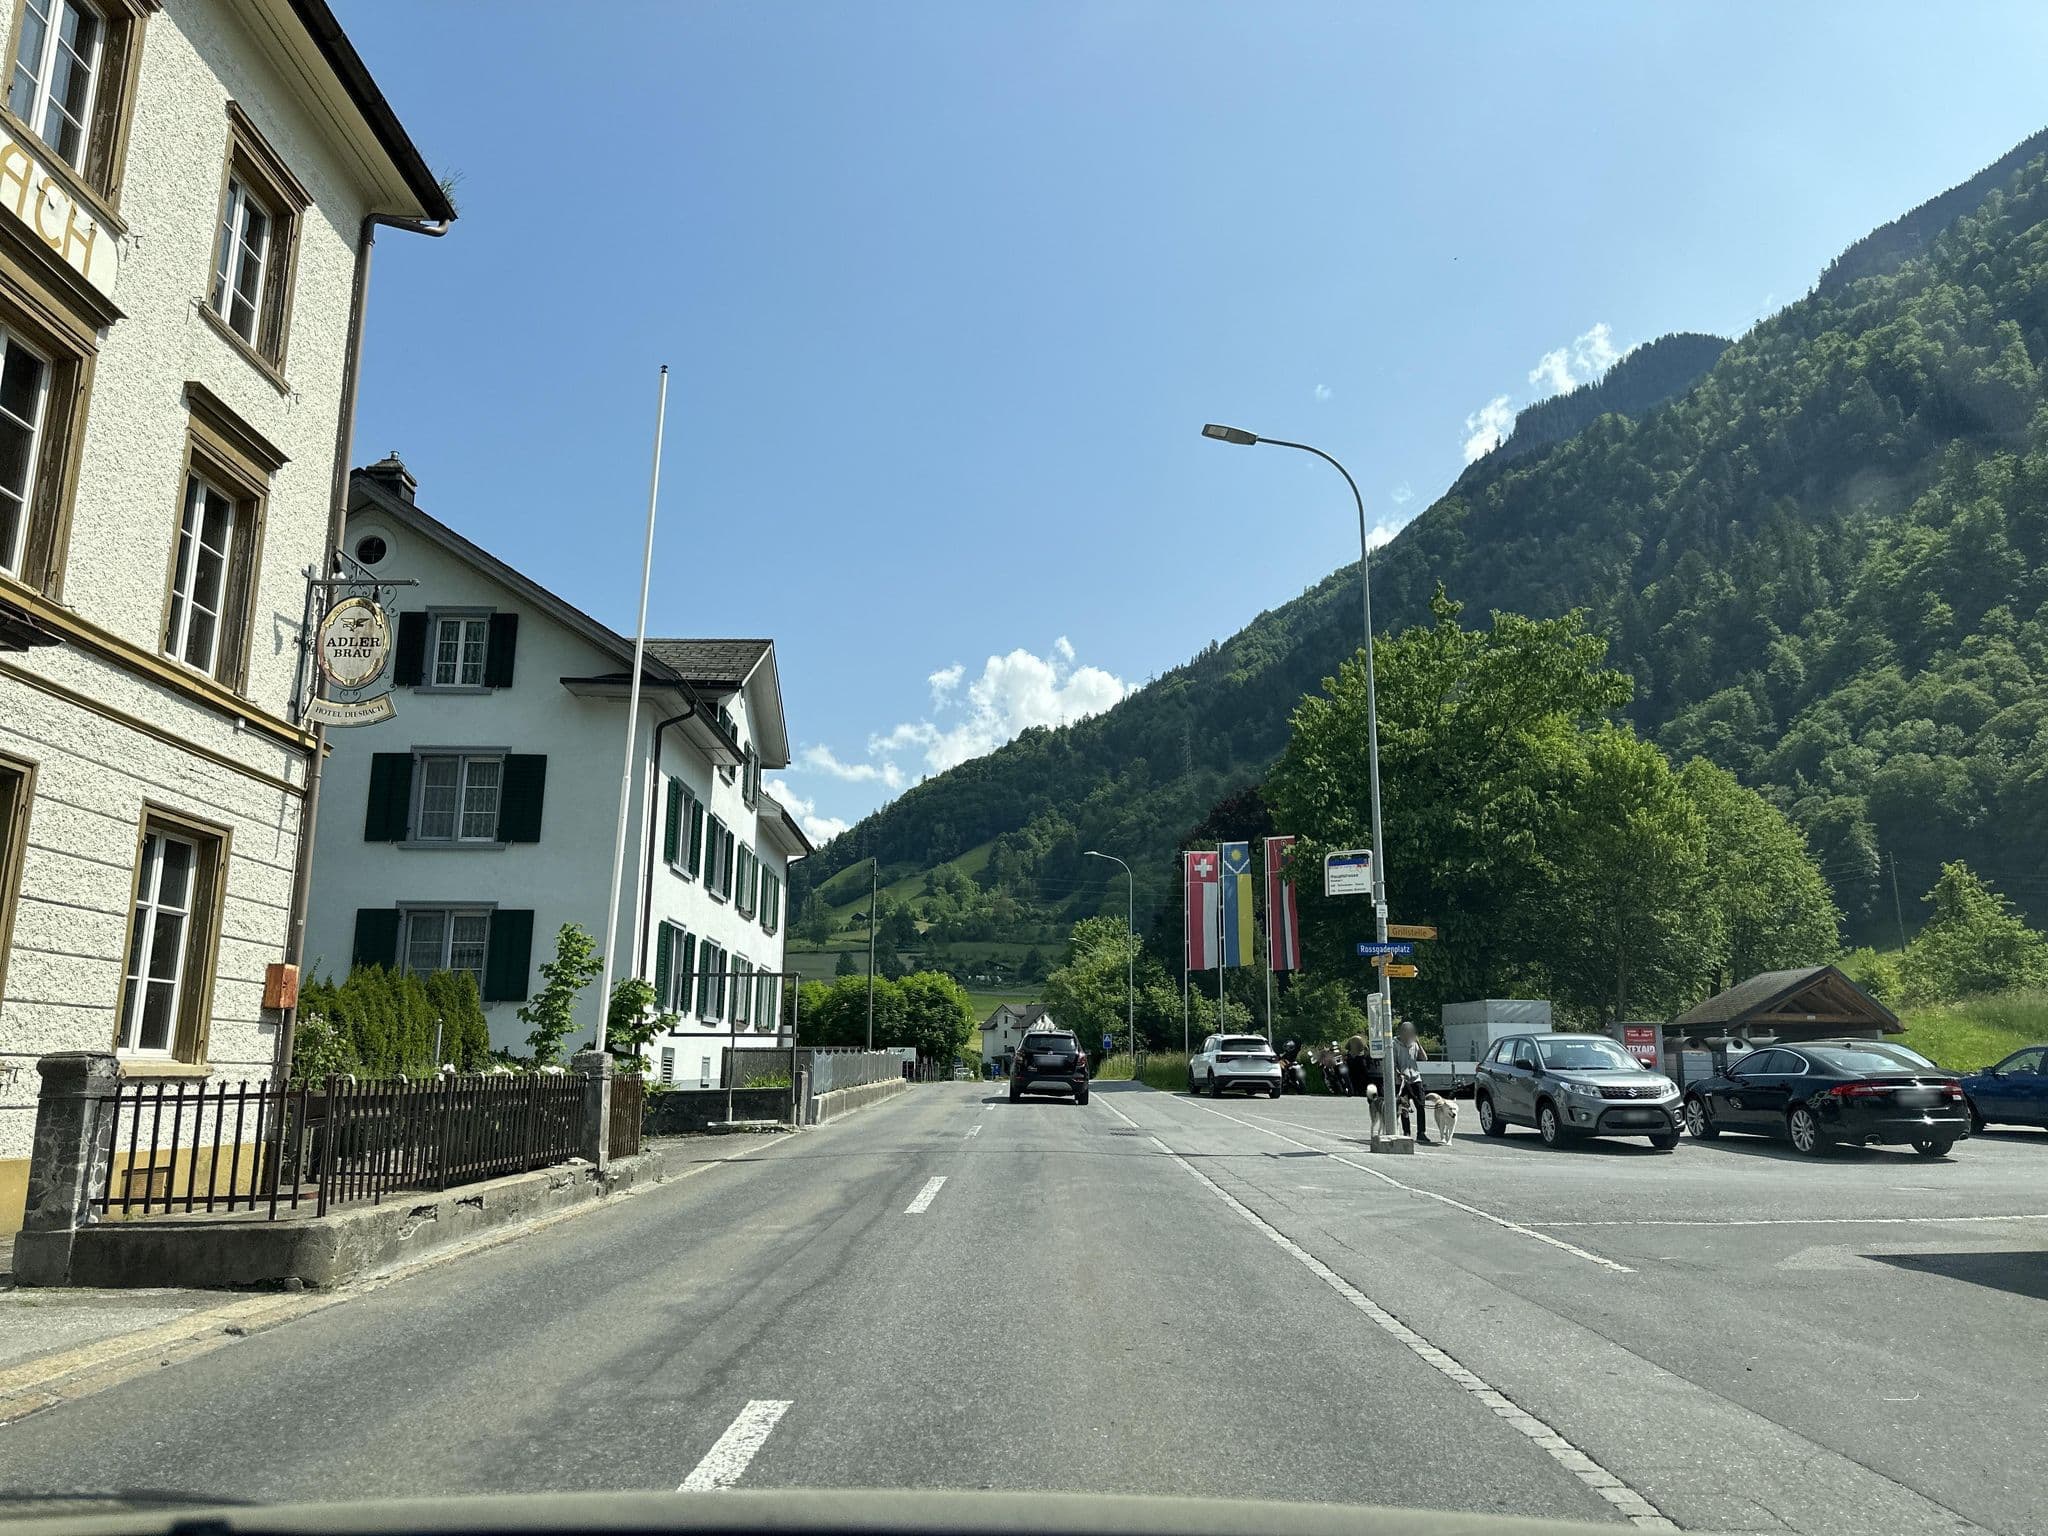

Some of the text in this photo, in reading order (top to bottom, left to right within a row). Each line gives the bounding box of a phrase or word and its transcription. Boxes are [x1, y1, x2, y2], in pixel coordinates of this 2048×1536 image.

[326, 637, 381, 648] ADLER
[333, 647, 372, 659] BRÄU
[315, 704, 384, 718] HOTEL DIESBACH
[1391, 926, 1428, 937] Grillstelle
[1360, 944, 1411, 955] Rossgadenplatz
[1626, 1045, 1656, 1054] TEXAID
